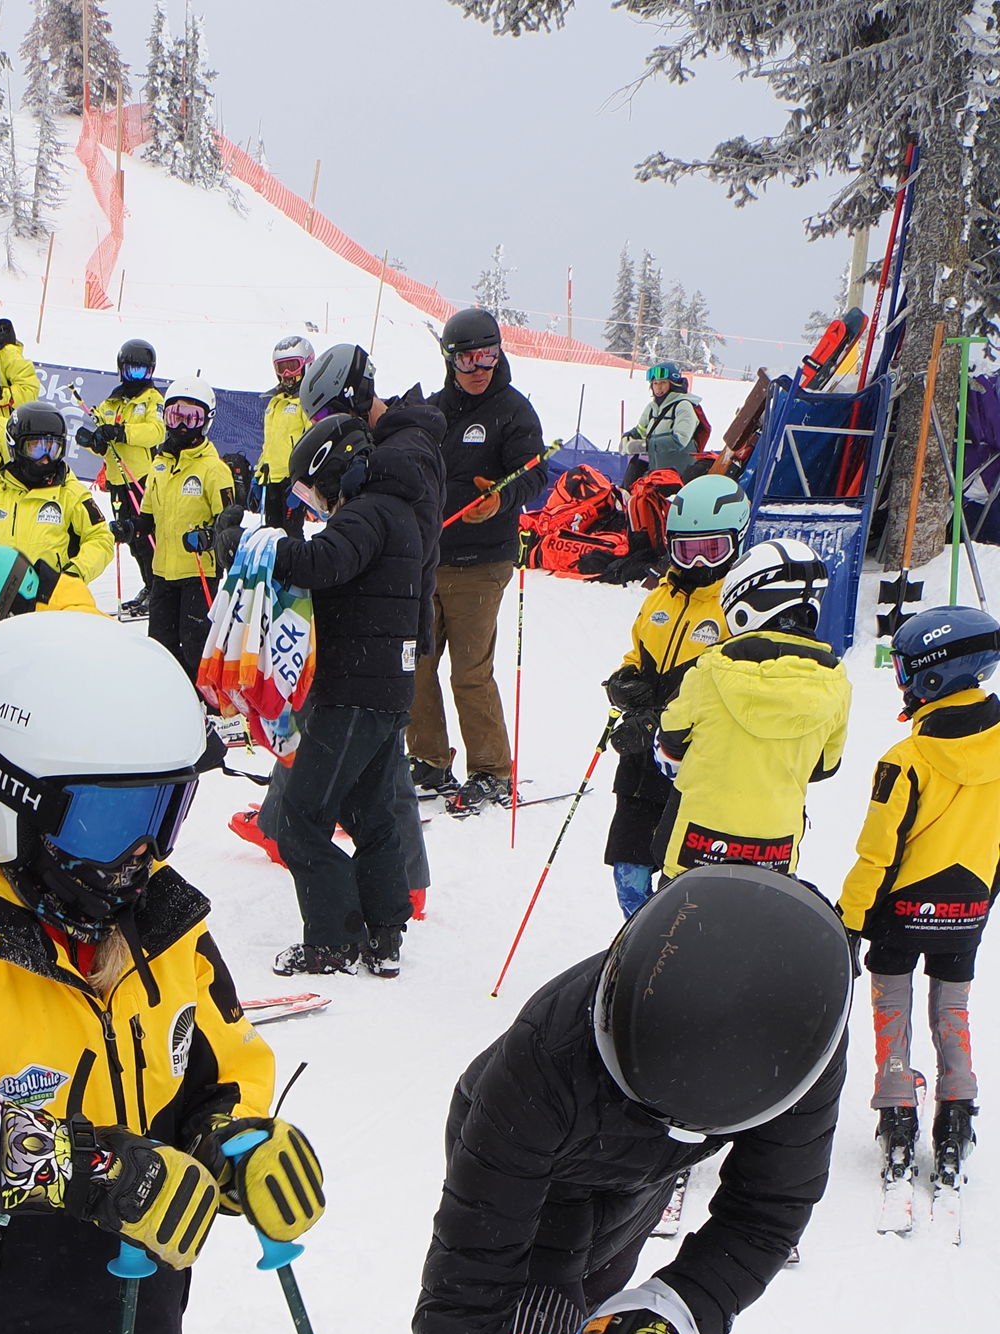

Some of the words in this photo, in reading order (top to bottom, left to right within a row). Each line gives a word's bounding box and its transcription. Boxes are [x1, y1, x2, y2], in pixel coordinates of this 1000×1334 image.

[723, 568, 783, 612] SCOTT
[922, 624, 952, 645] poc
[910, 648, 948, 669] SMITH
[217, 721, 240, 730] HEAD
[895, 899, 990, 918] SHORELINE
[30, 1092, 54, 1101] RESORT
